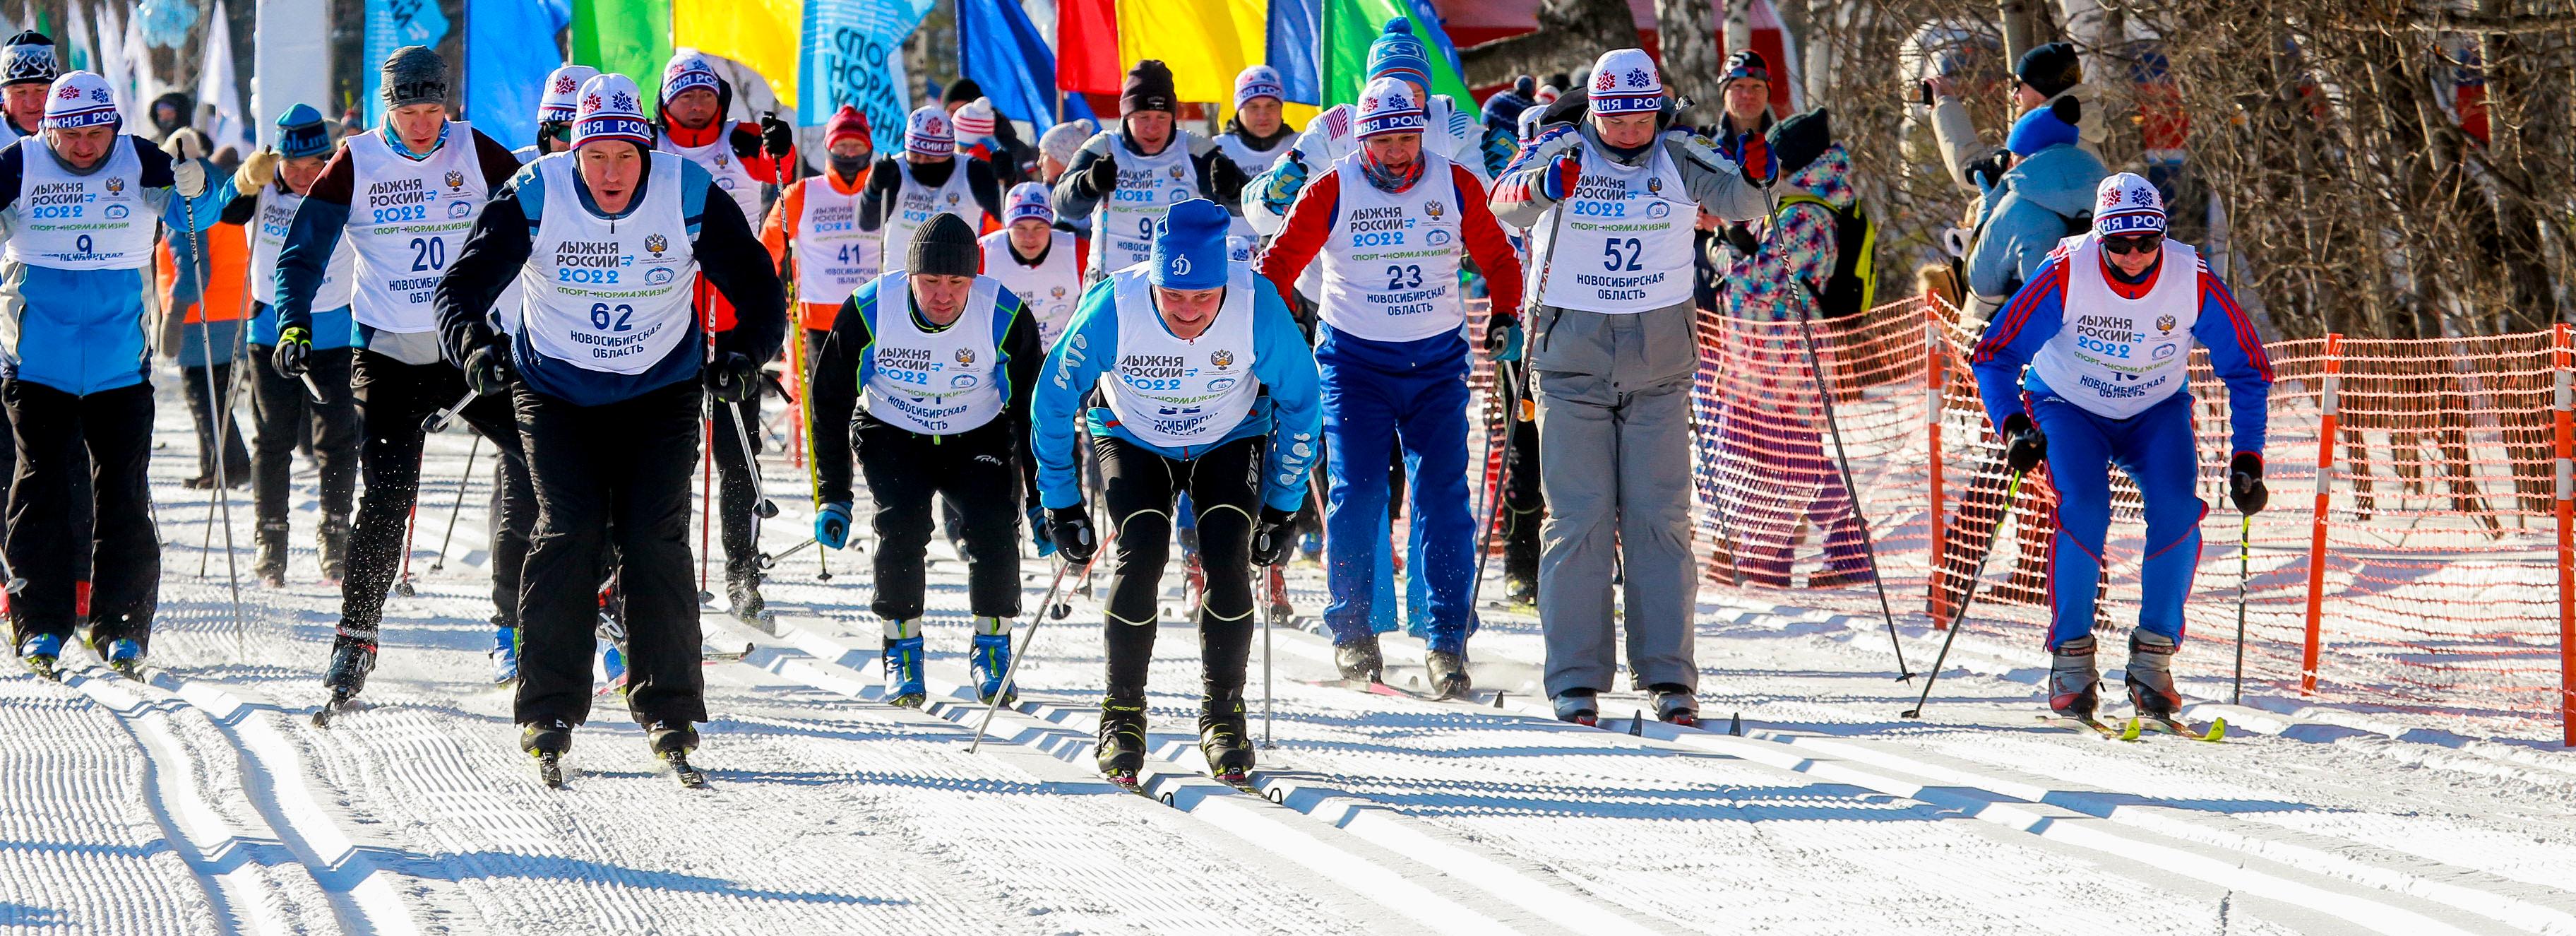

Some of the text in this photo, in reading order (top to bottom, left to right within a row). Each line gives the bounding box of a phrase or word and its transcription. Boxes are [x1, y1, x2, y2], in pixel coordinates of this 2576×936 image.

[31, 182, 83, 196] ЛЫЖНЯ
[368, 179, 423, 195] ЛЫЖНЯ
[1577, 174, 1625, 189] ЛЫЖНЯ
[32, 194, 83, 206] РОССИИ
[370, 191, 424, 208] РОССИИ
[776, 170, 787, 233] FISCHER
[1115, 190, 1153, 201] 2022
[1574, 187, 1625, 201] РОССИИ
[32, 206, 83, 218] 2022
[373, 205, 426, 223] 2022
[1349, 206, 1402, 221] ЛЫЖНЯ
[1573, 200, 1625, 217] 2022
[812, 214, 852, 223] РОССИИ
[1350, 219, 1403, 232] РОССИИ
[1570, 222, 1597, 231] СПОРТ
[1639, 222, 1670, 231] ЖИЗНИ
[187, 216, 197, 255] NORDWAY
[374, 221, 472, 235] СПОРТ НОРМА ЖИЗНИ
[76, 234, 93, 256] 9
[1353, 232, 1405, 247] 2022
[410, 236, 445, 273] 20
[556, 242, 619, 254] ЛЫЖНЯ
[837, 244, 859, 265] 41
[1386, 251, 1419, 259] НОРМА
[1421, 248, 1450, 256] ЖИЗНИ
[1604, 237, 1642, 271] 52
[556, 255, 619, 268] РОССИИ
[559, 268, 619, 284] 2022
[1387, 264, 1423, 290] 23
[1577, 272, 1664, 288] НОВОСИБИРСКАЯ
[557, 286, 588, 297] СПОРТ
[638, 285, 673, 297] ЖИЗНИ
[1367, 285, 1445, 304] НОВОСИБИРСКАЯ
[1598, 289, 1646, 301] ОБЛАСТЬ
[591, 302, 633, 332] 62
[1388, 302, 1433, 316] ОБЛАСТЬ
[2077, 314, 2133, 330] ЛЫЖНЯ
[571, 322, 662, 347] НОВОСИБИРСКАЯ
[2077, 325, 2132, 343] РОССИИ
[593, 344, 644, 359] ОБЛАСТЬ
[878, 348, 931, 360] ЛЫЖНЯ
[2077, 336, 2130, 359] 2022
[1121, 355, 1183, 367] ЛЫЖНЯ
[2074, 351, 2100, 366] СПОРТ
[2106, 362, 2144, 373] НОРМА
[878, 367, 927, 385] 2022
[1123, 374, 1181, 390] 2022
[2080, 375, 2166, 395] НОВОСИБИРСКАЯ
[888, 395, 968, 418] НОВОСИБИРСКАЯ
[907, 415, 948, 430] АСТЬ
